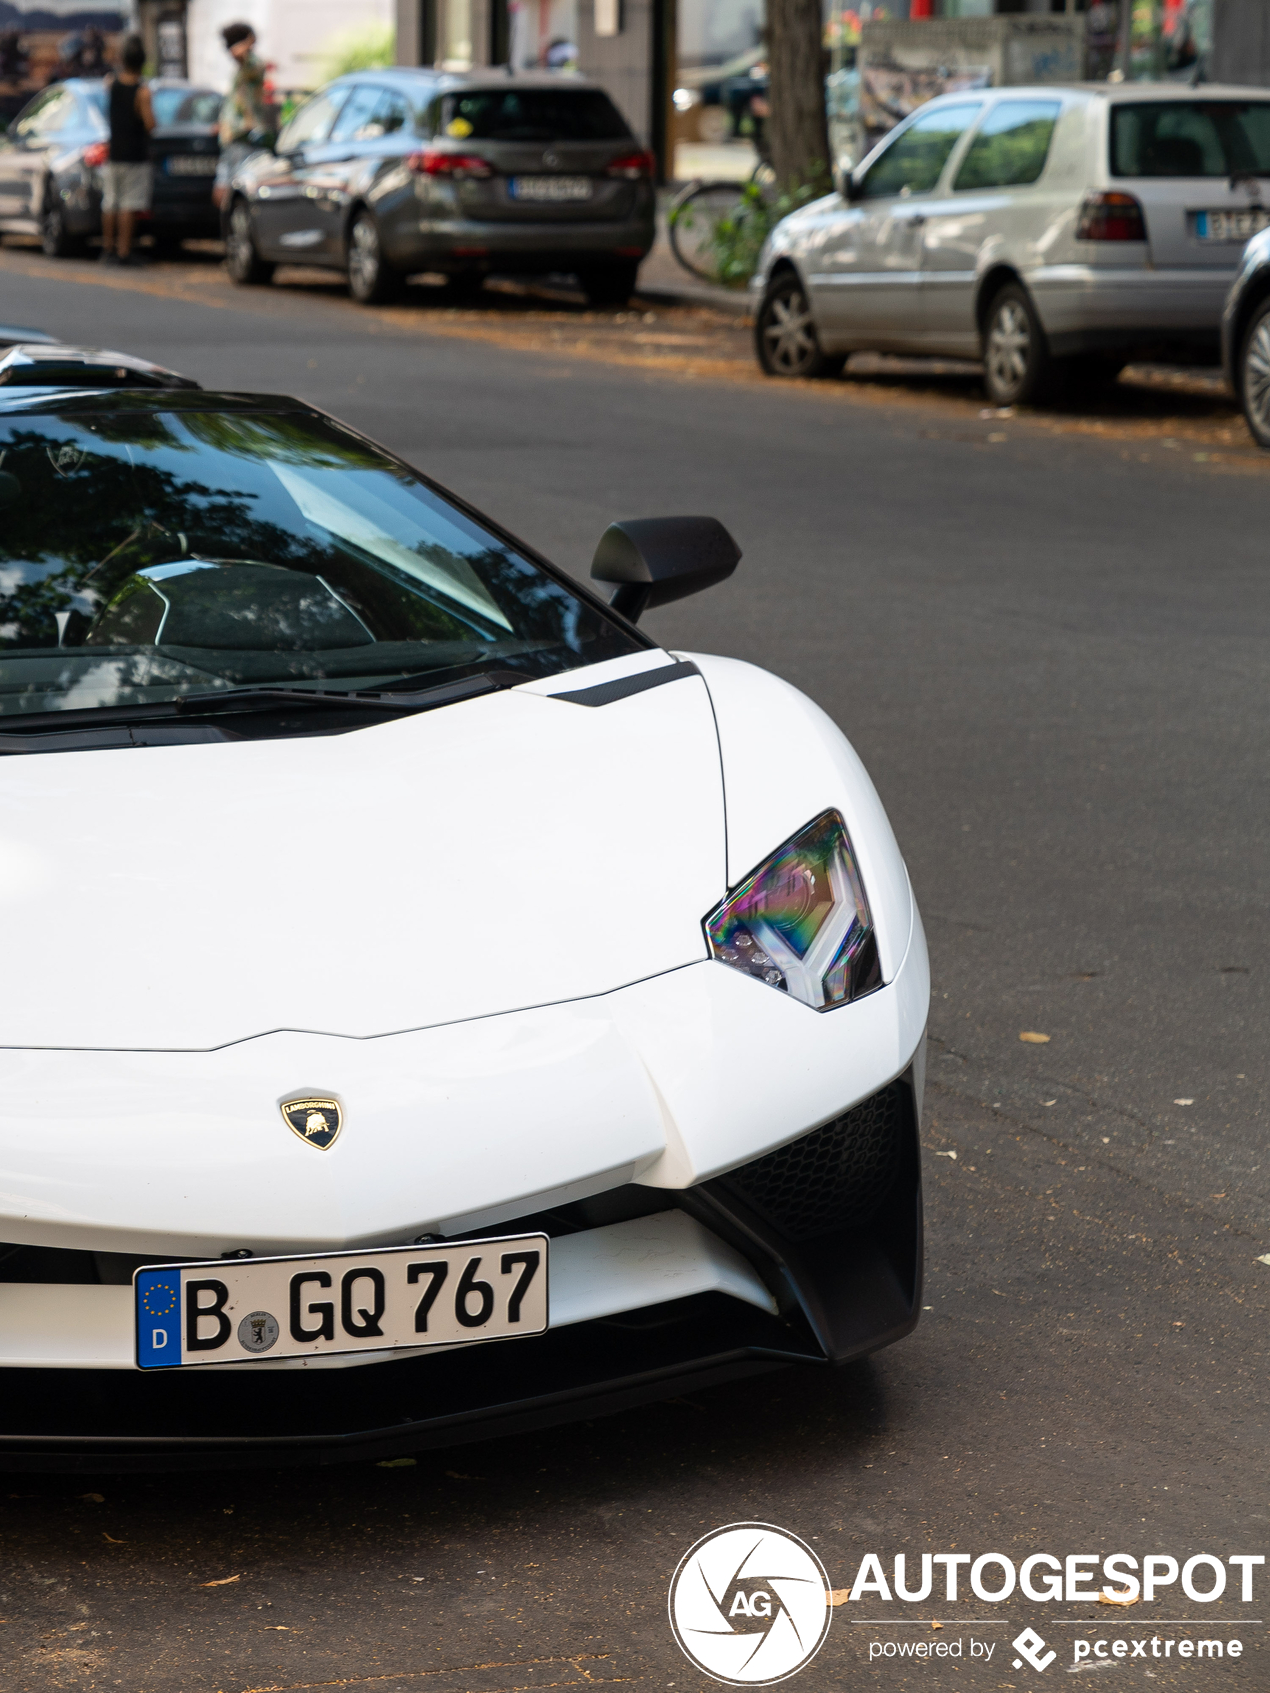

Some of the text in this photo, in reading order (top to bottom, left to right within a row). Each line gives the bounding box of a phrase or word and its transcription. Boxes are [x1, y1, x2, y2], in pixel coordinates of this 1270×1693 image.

[186, 1250, 540, 1352] B GQ 767
[152, 1328, 168, 1349] D
